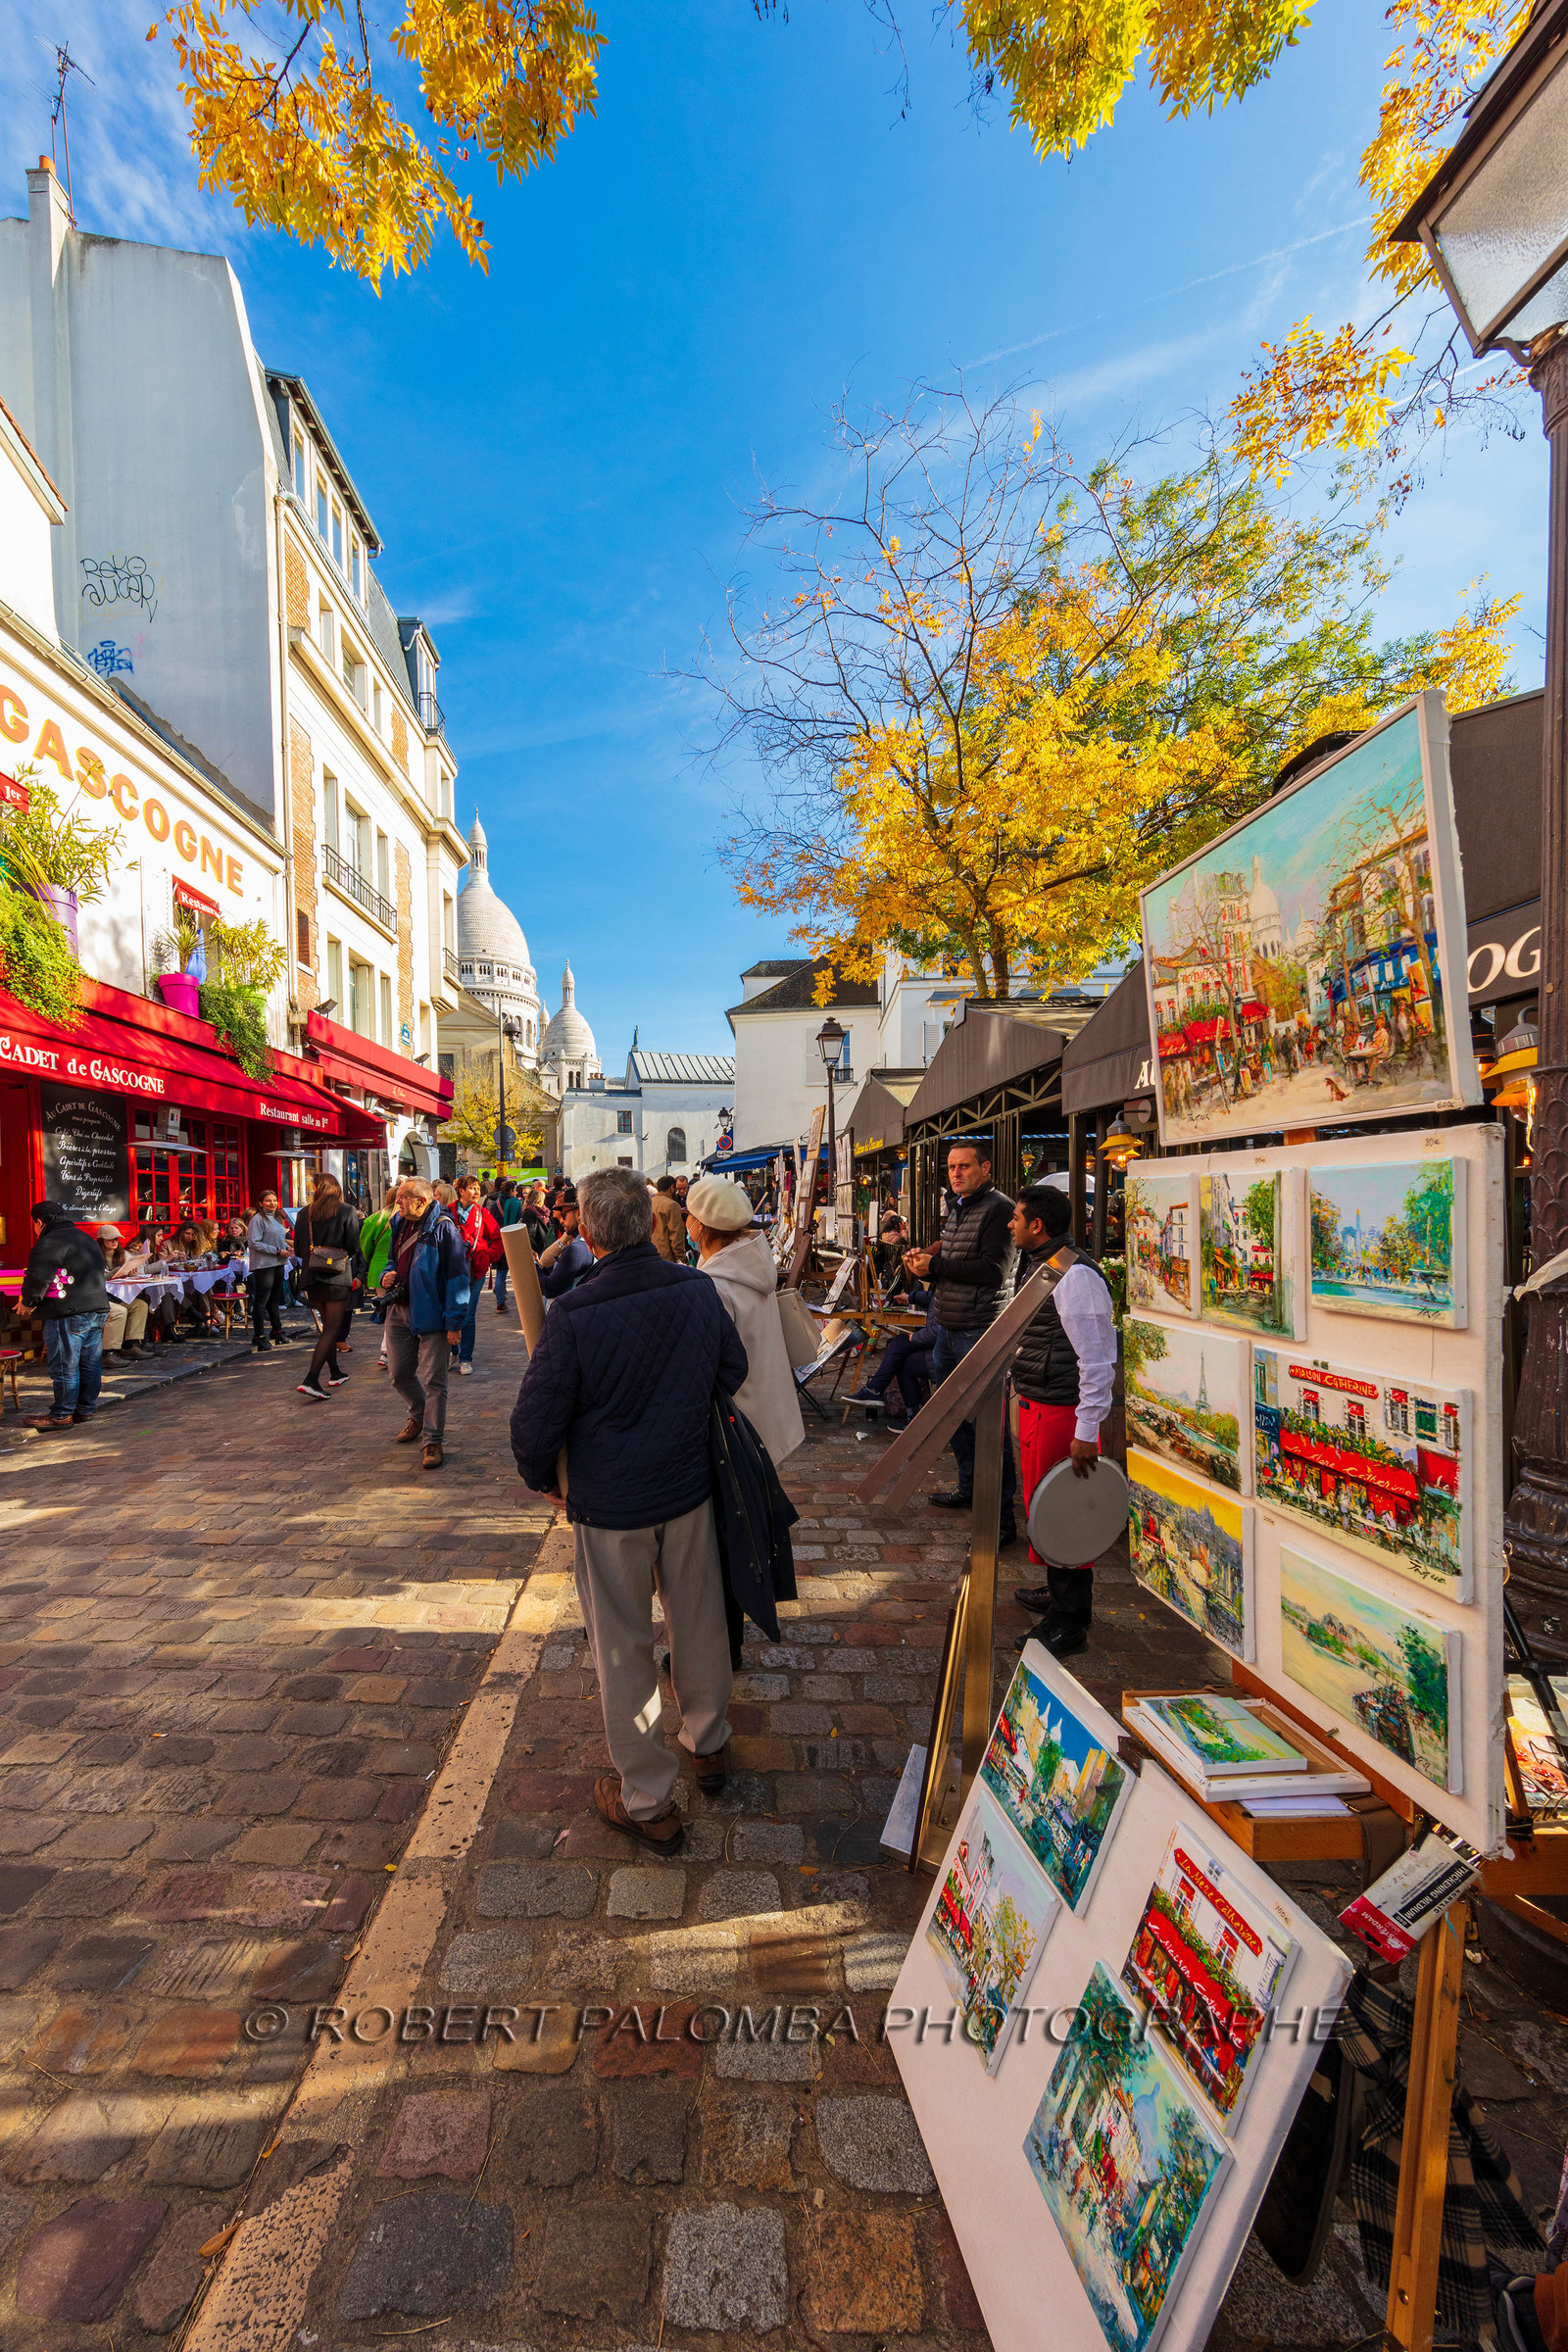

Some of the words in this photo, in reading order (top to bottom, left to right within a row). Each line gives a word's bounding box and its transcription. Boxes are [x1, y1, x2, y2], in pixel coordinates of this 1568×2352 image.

[0, 684, 244, 898] GASCOGNE
[0, 1035, 60, 1071] CADET
[67, 1058, 88, 1076] de
[90, 1059, 166, 1095] GASCOGNE
[260, 1102, 300, 1123] Restaurant
[301, 1113, 315, 1126] salle
[57, 1140, 80, 1152] Bières
[92, 1148, 117, 1157] pression
[61, 1170, 76, 1182] Vins
[74, 1185, 103, 1201] Digestifs
[1295, 1367, 1321, 1383] MAISON
[1323, 1375, 1375, 1396] CATHERINE
[1431, 1865, 1469, 1898] THICKENING
[1403, 1895, 1434, 1920] MEDIUM
[1434, 1888, 1461, 1915] ACRYLIC
